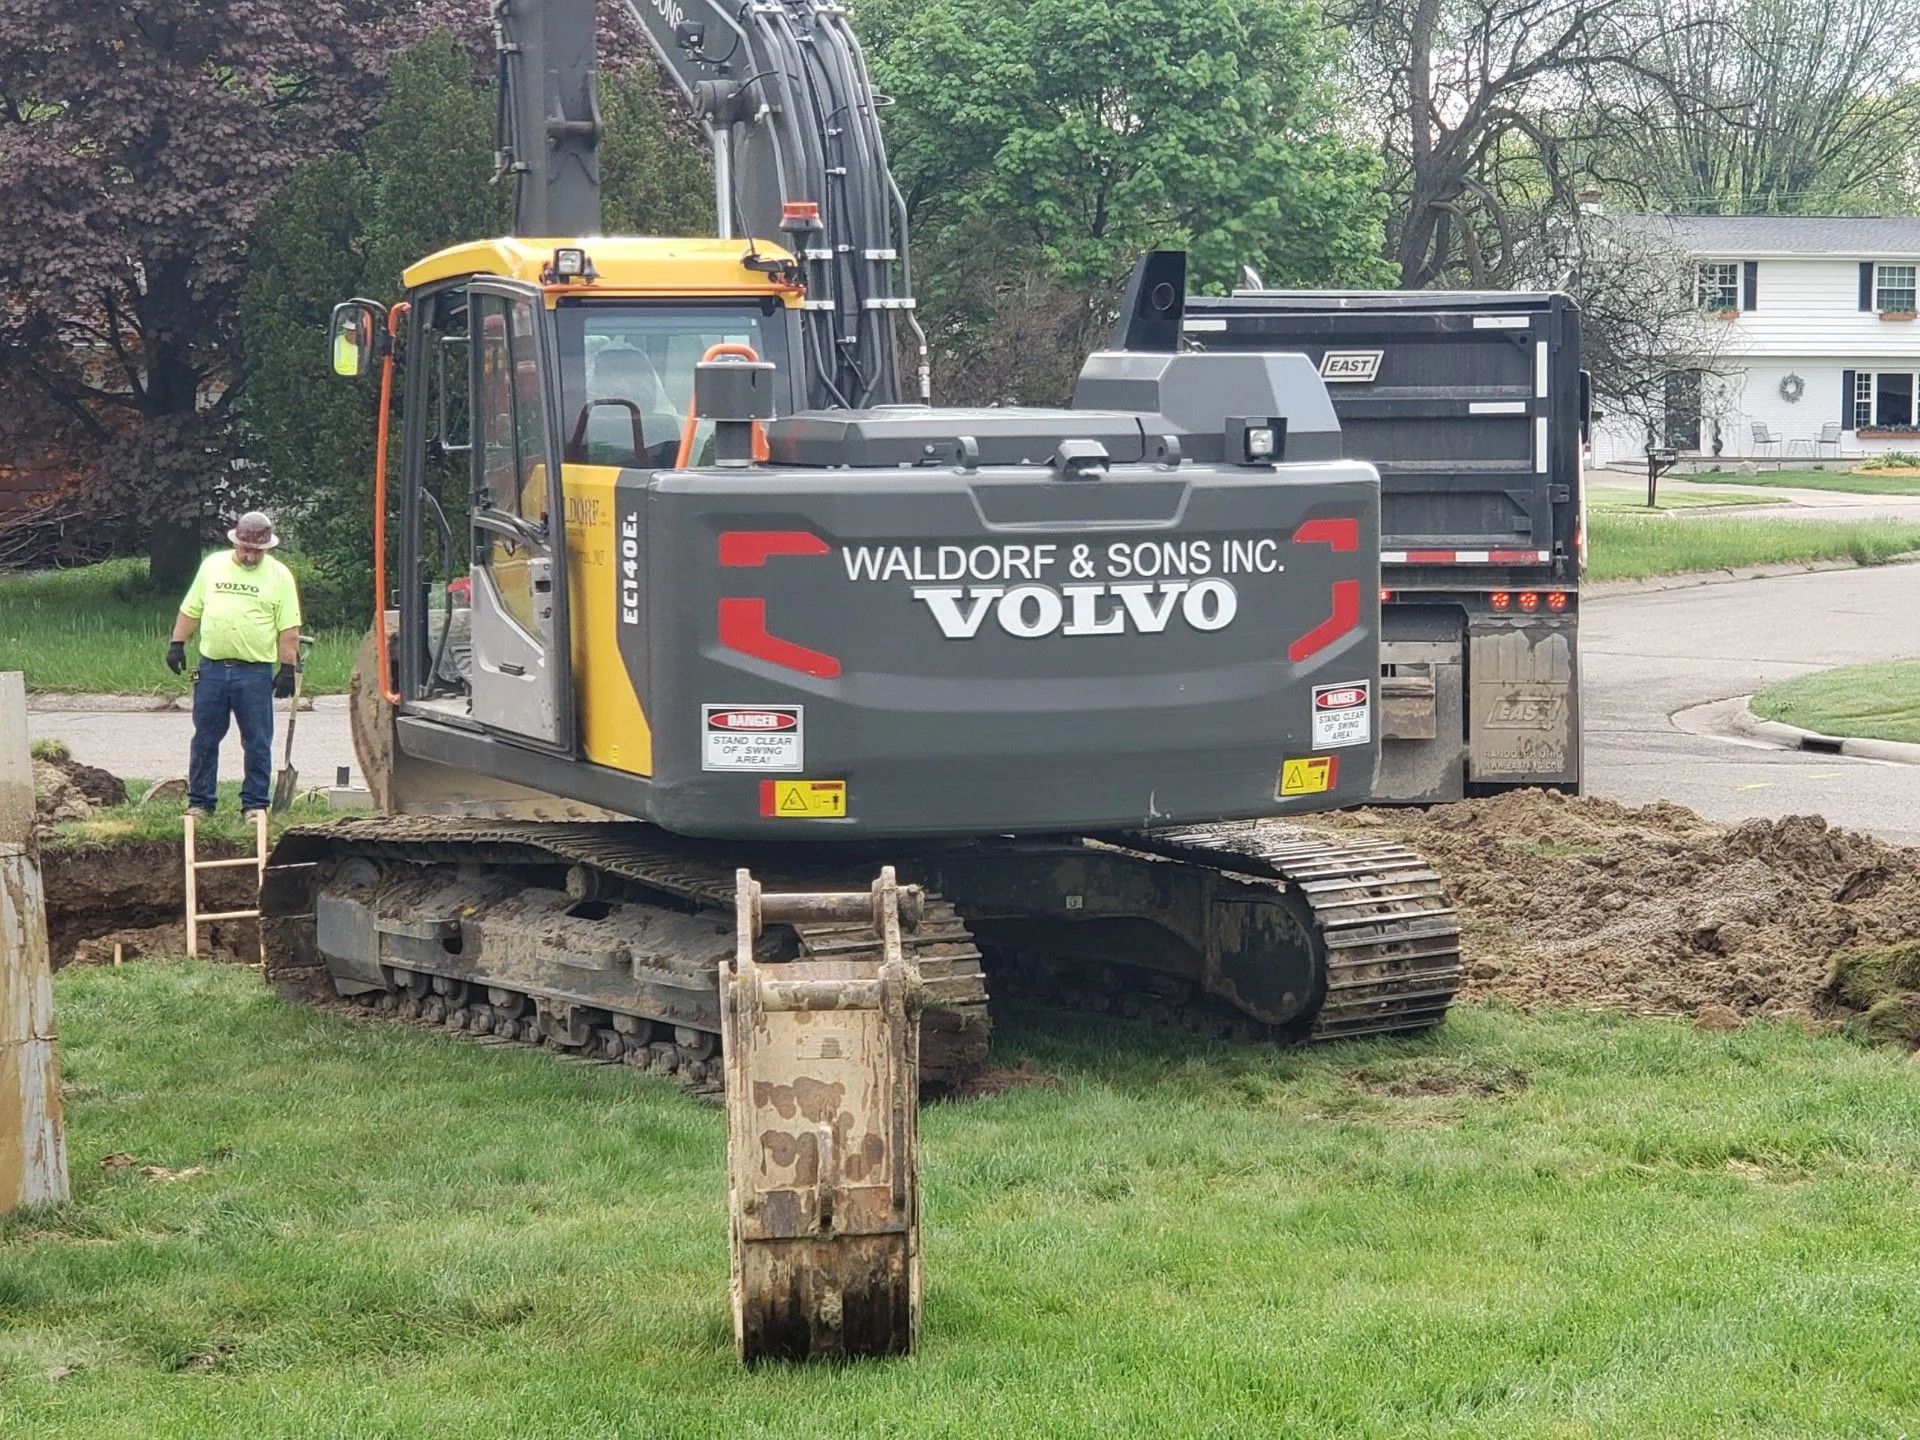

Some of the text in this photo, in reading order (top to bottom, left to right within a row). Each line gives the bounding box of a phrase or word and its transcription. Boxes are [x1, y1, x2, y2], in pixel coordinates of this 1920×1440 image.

[651, 0, 684, 31] ONS
[1329, 360, 1371, 372] EAST
[842, 539, 1285, 581] WALDORF & SONS INC.
[215, 582, 260, 593] VOLVO
[911, 577, 1238, 638] VOLVO
[1318, 710, 1364, 724] STAND CLEAR
[1500, 702, 1553, 721] EAST
[727, 714, 778, 727] DANGER
[1324, 721, 1359, 732] OF SWING
[713, 736, 792, 746] STAND CLEAR
[722, 746, 783, 755] OF SWING
[1539, 750, 1563, 759] OHIO
[735, 756, 771, 764] AREA!
